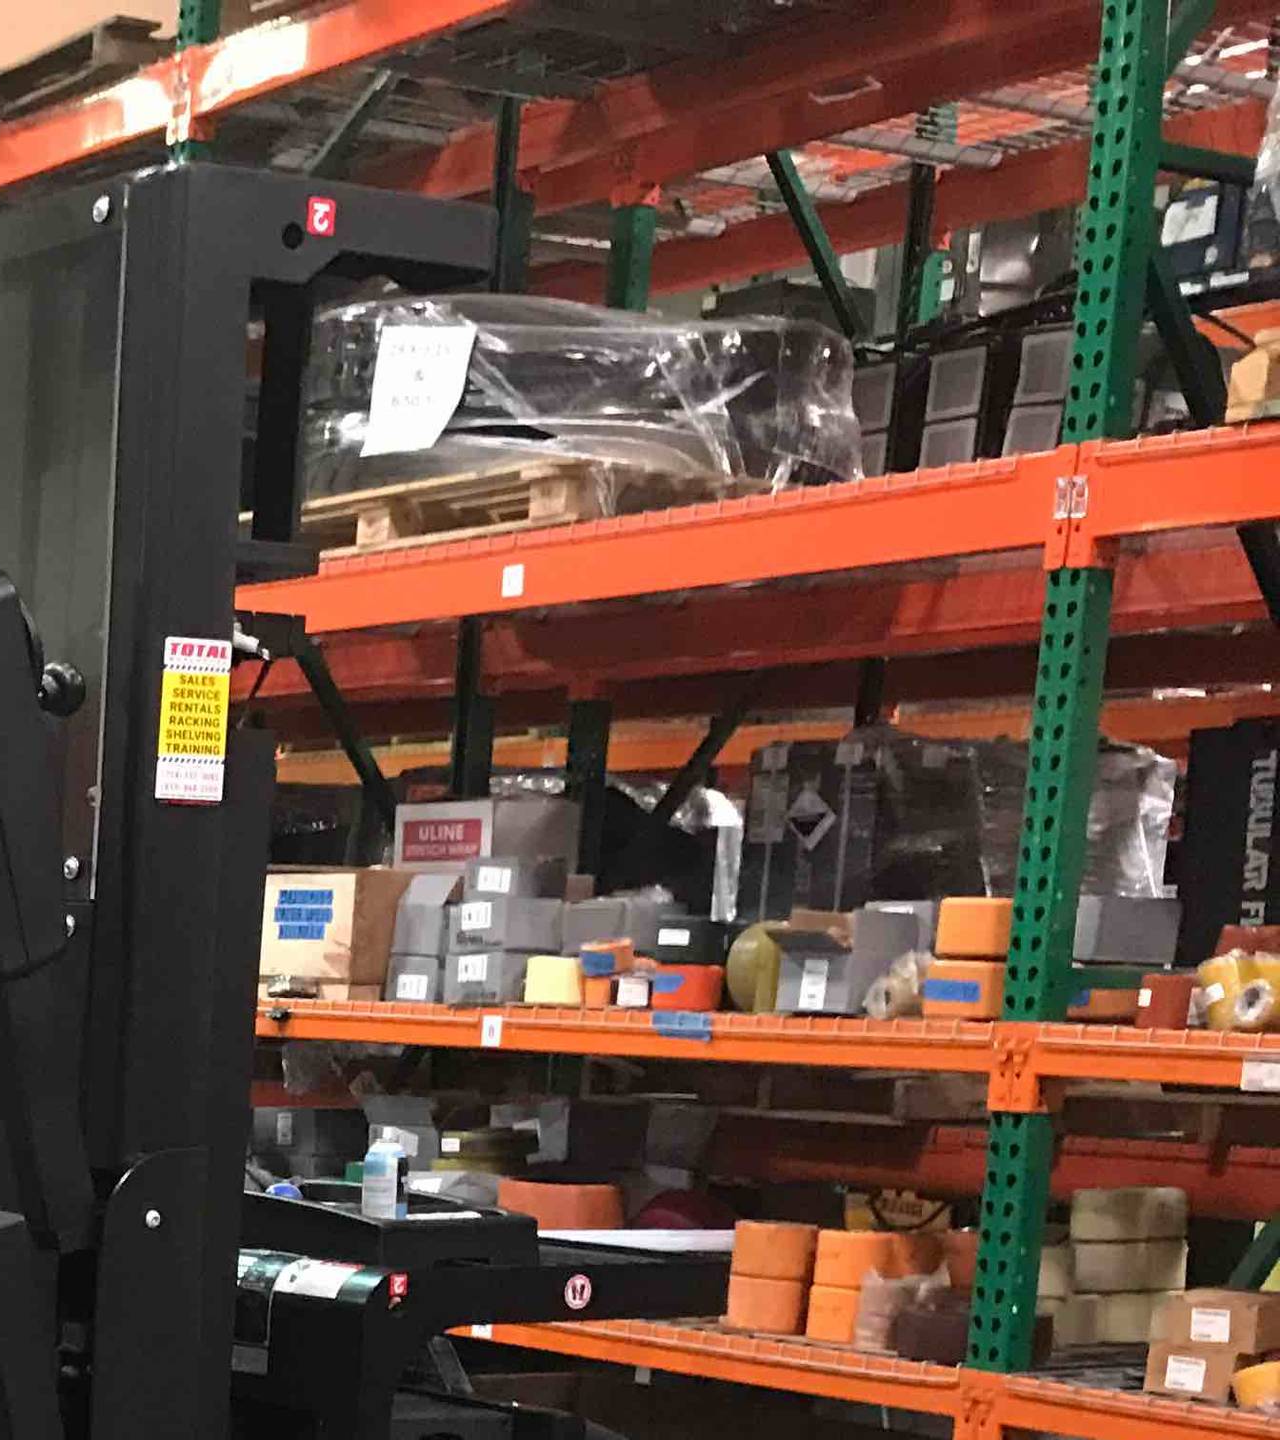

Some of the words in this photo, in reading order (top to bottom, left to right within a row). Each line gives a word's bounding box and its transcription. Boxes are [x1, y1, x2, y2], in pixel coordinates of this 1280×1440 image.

[169, 642, 228, 659] TOTAL
[179, 674, 216, 687] SALES
[172, 687, 221, 701] SERVICE
[169, 701, 222, 715] RENTALS
[168, 714, 221, 729] RACKING
[166, 729, 222, 743] SHELVING
[166, 742, 221, 756] TRAINING
[418, 823, 465, 841] ULINE
